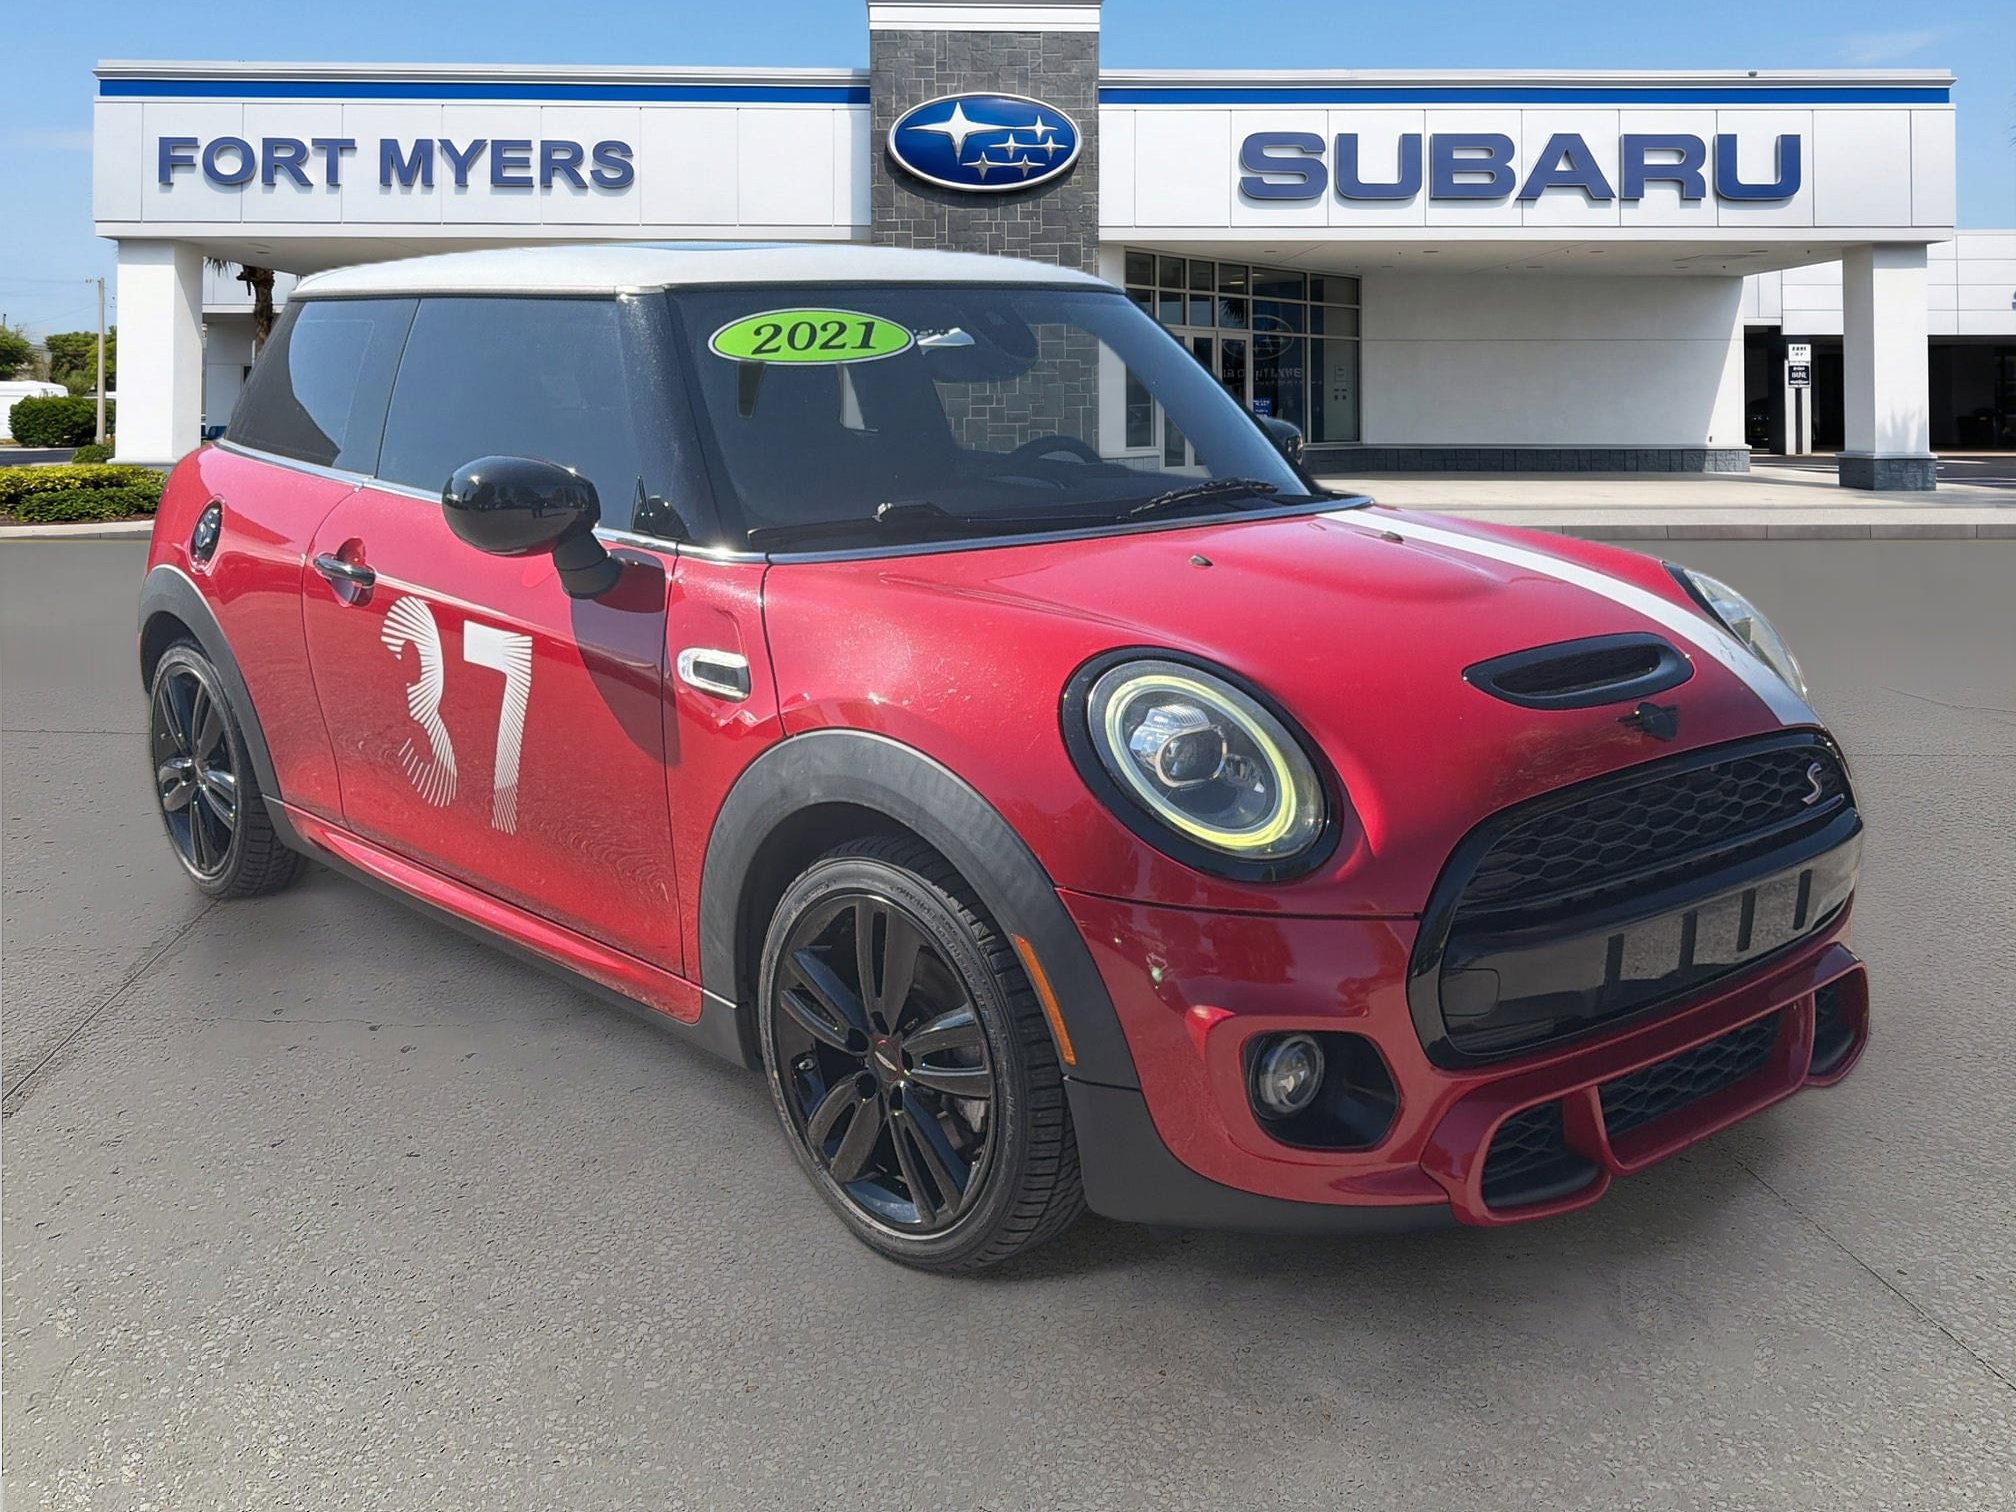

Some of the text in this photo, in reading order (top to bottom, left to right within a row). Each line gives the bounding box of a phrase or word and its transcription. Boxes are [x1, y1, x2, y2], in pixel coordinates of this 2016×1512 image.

[157, 136, 635, 189] FORT MYERS
[1239, 131, 1801, 200] SUBARU
[751, 320, 878, 355] 2021
[380, 595, 533, 836] 37
[1801, 762, 1822, 805] S
